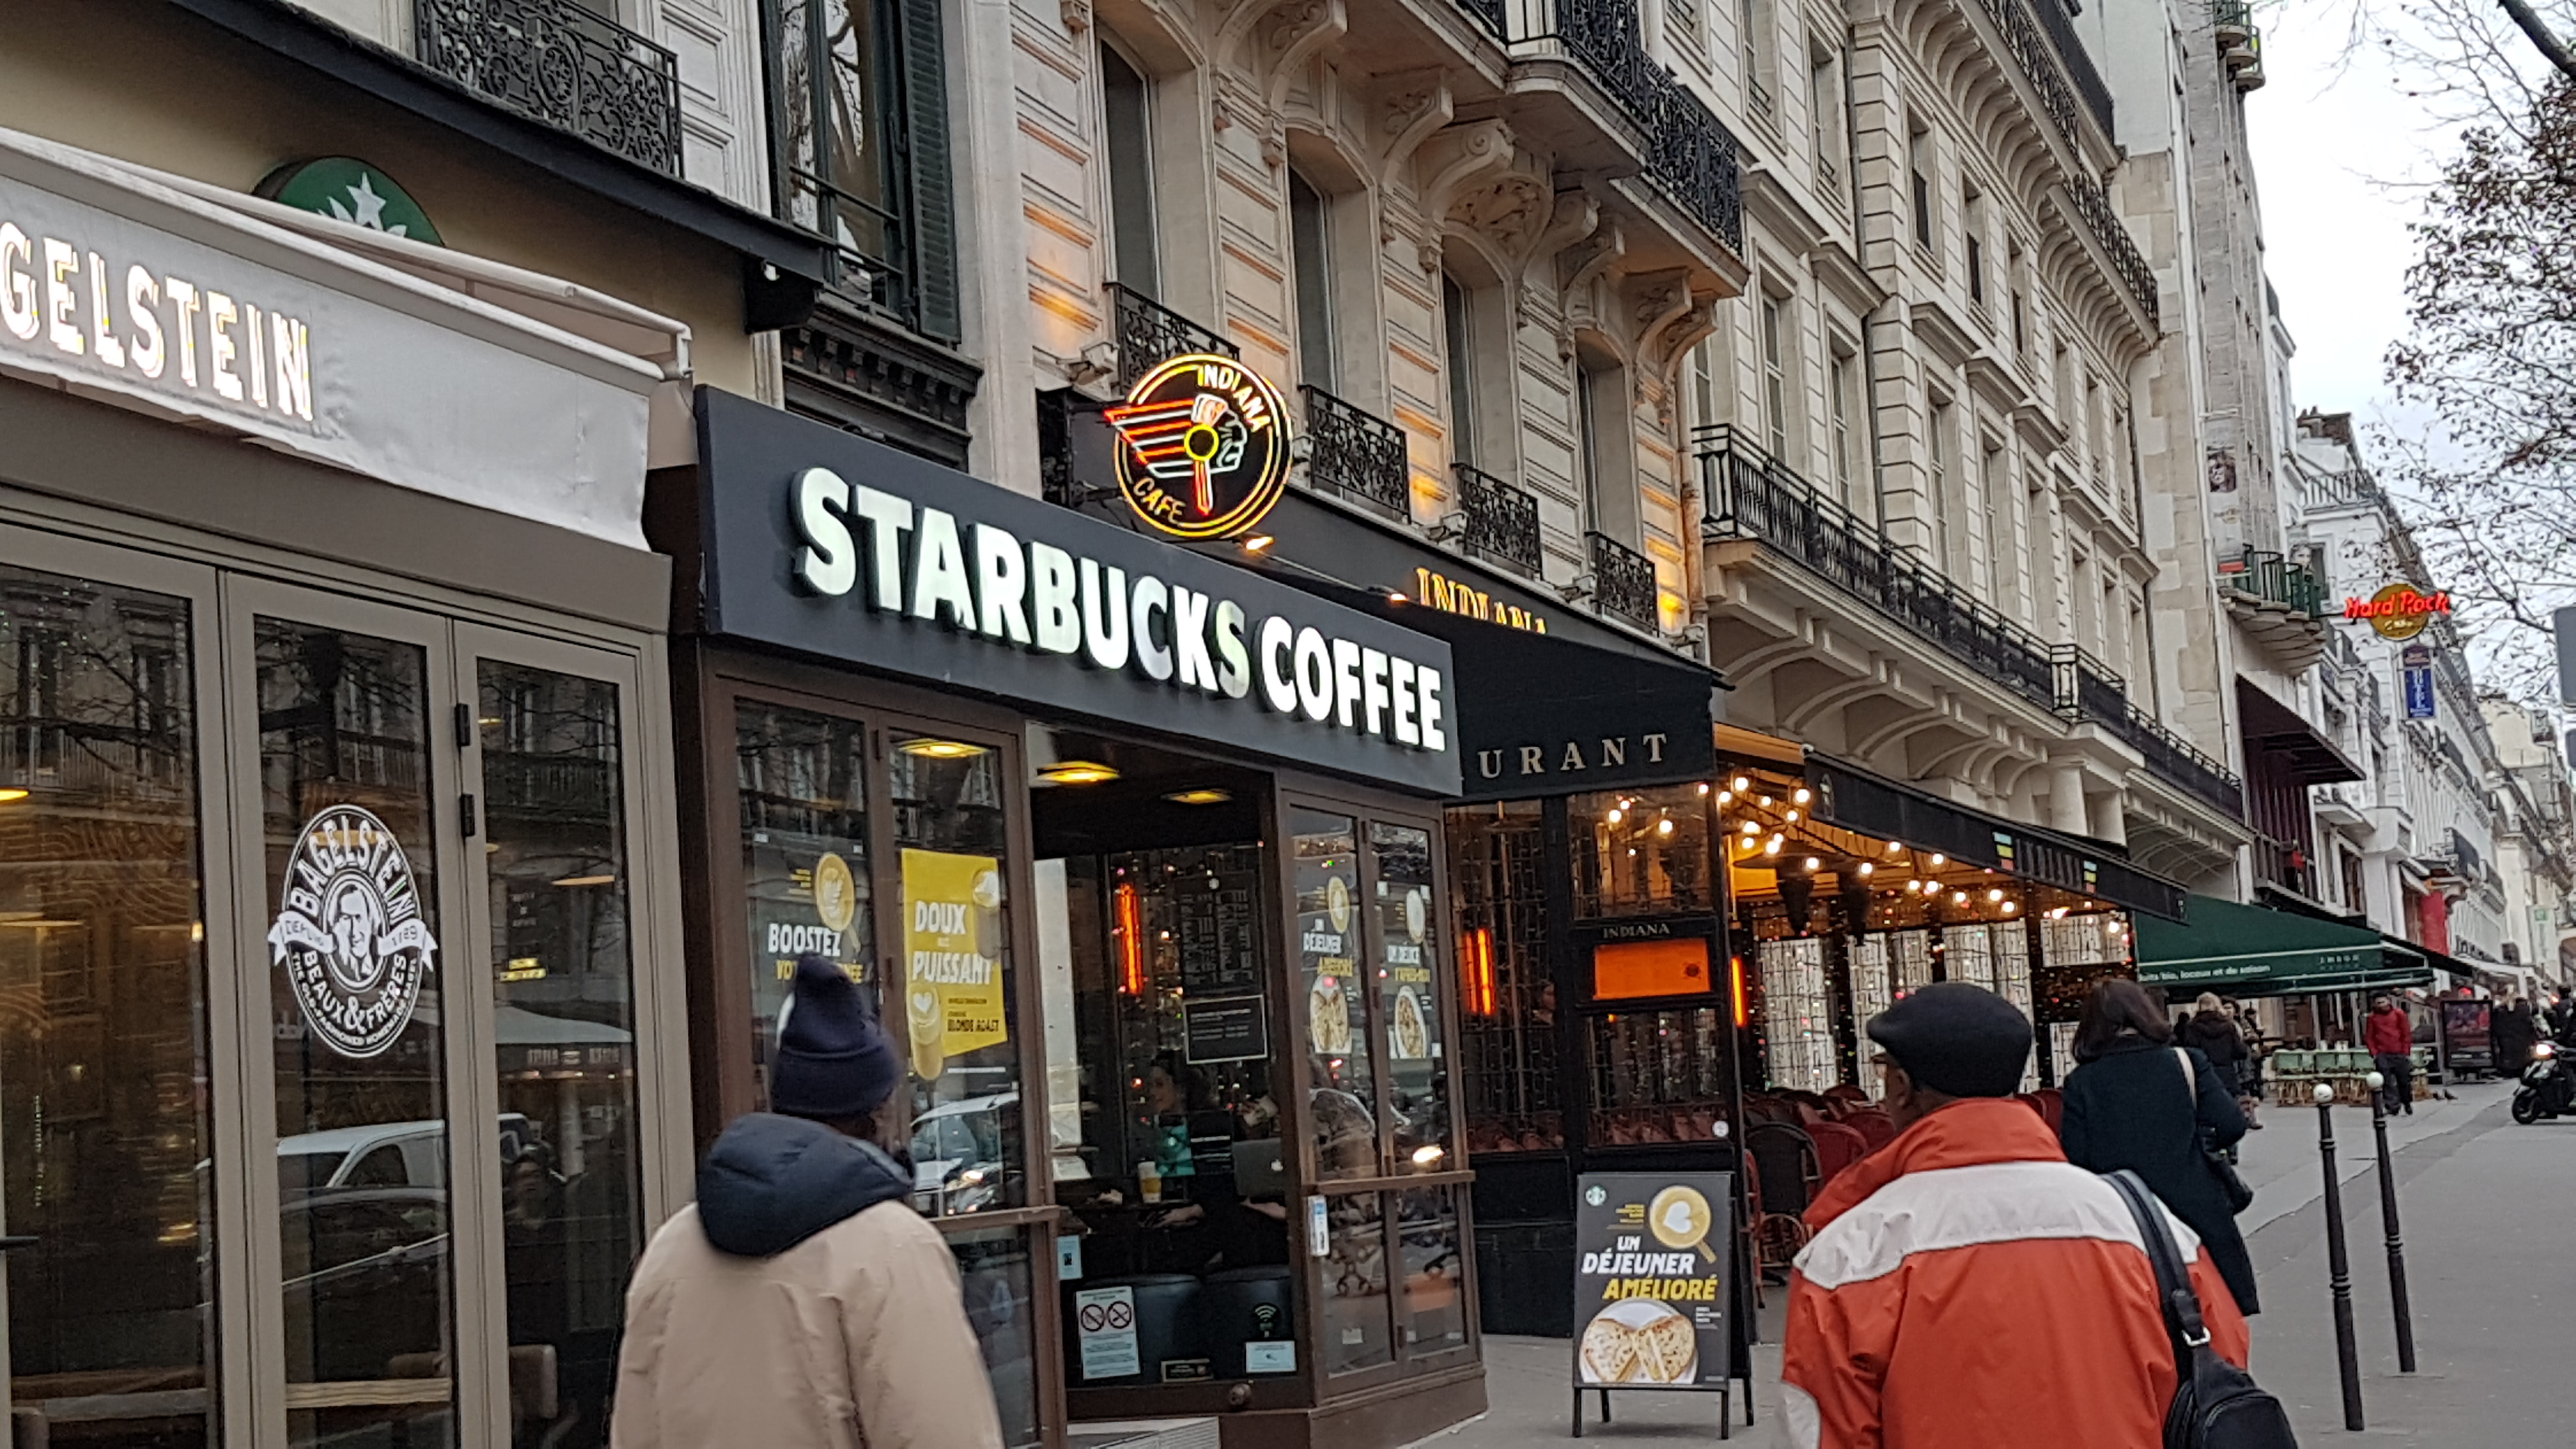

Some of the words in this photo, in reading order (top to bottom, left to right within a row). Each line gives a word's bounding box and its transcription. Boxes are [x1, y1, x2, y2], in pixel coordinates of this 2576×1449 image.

[0, 221, 313, 422] GELSTEIN
[1197, 364, 1272, 433] INDIANA
[1133, 477, 1186, 525] CAFE
[792, 466, 1250, 699] STARBUCKS
[1257, 615, 1446, 752] COFFEE
[2343, 592, 2395, 618] Hard
[2400, 590, 2451, 616] Rock
[1478, 733, 1668, 779] URANT
[290, 815, 417, 926] BAGELSTEIN
[914, 900, 967, 935] DOUX
[1602, 923, 1670, 939] INDIANA
[768, 923, 841, 956] BOOSTEZ
[911, 951, 994, 985] PUISSANT
[302, 950, 346, 1024] BEAUX
[343, 995, 367, 1035] &
[1581, 1247, 1696, 1275] DÉJEUNER
[1617, 1235, 1641, 1252] UN
[1602, 1273, 1719, 1301] AMÉLIORÉ
